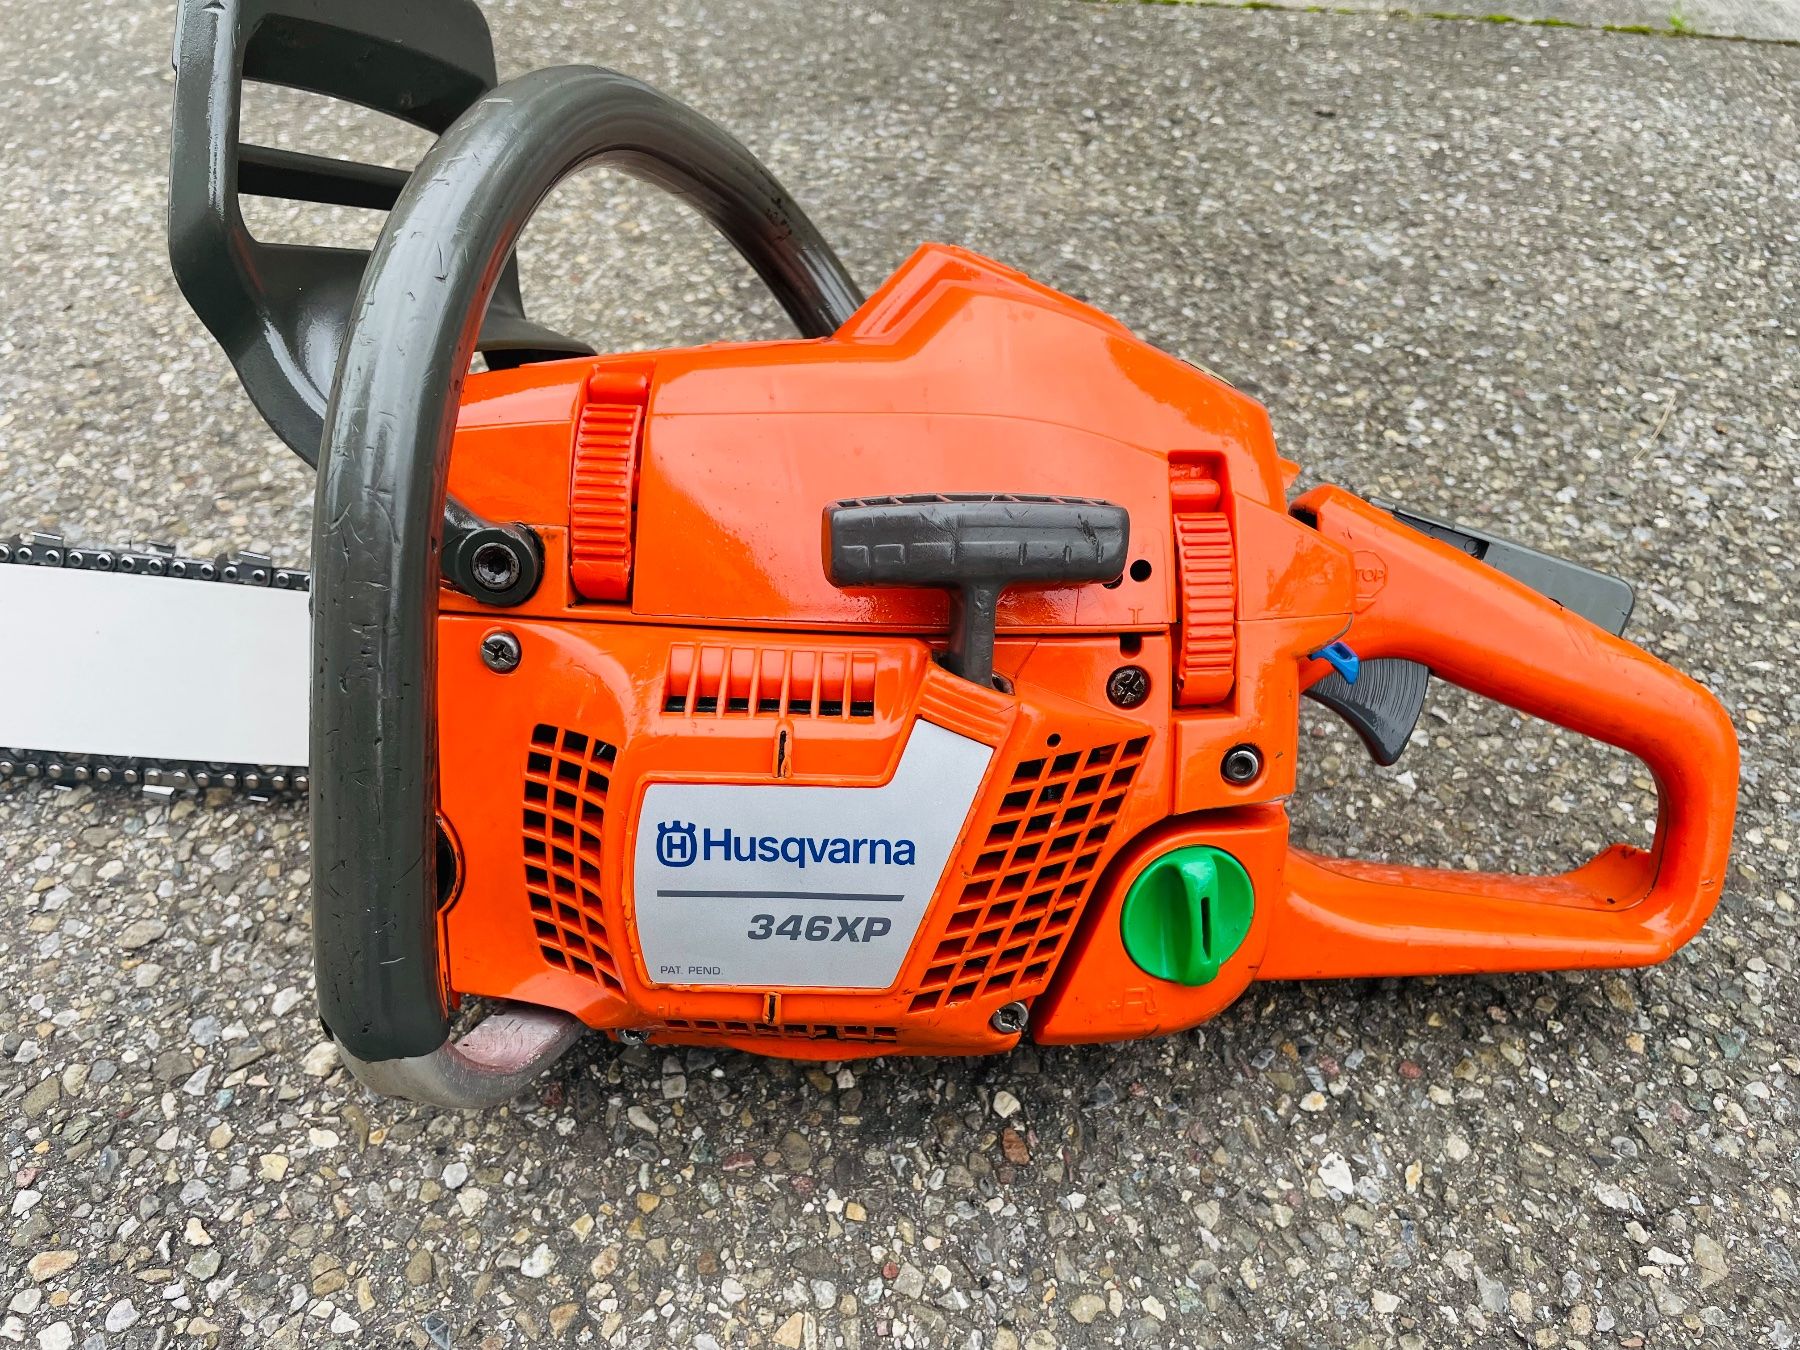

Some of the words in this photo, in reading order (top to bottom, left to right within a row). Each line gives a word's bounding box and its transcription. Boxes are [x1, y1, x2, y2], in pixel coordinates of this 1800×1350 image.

[1353, 568, 1384, 583] TOP
[703, 827, 916, 868] Husqvarna
[747, 913, 892, 943] 346XP
[660, 965, 684, 975] PAT.
[688, 966, 724, 976] PEND.
